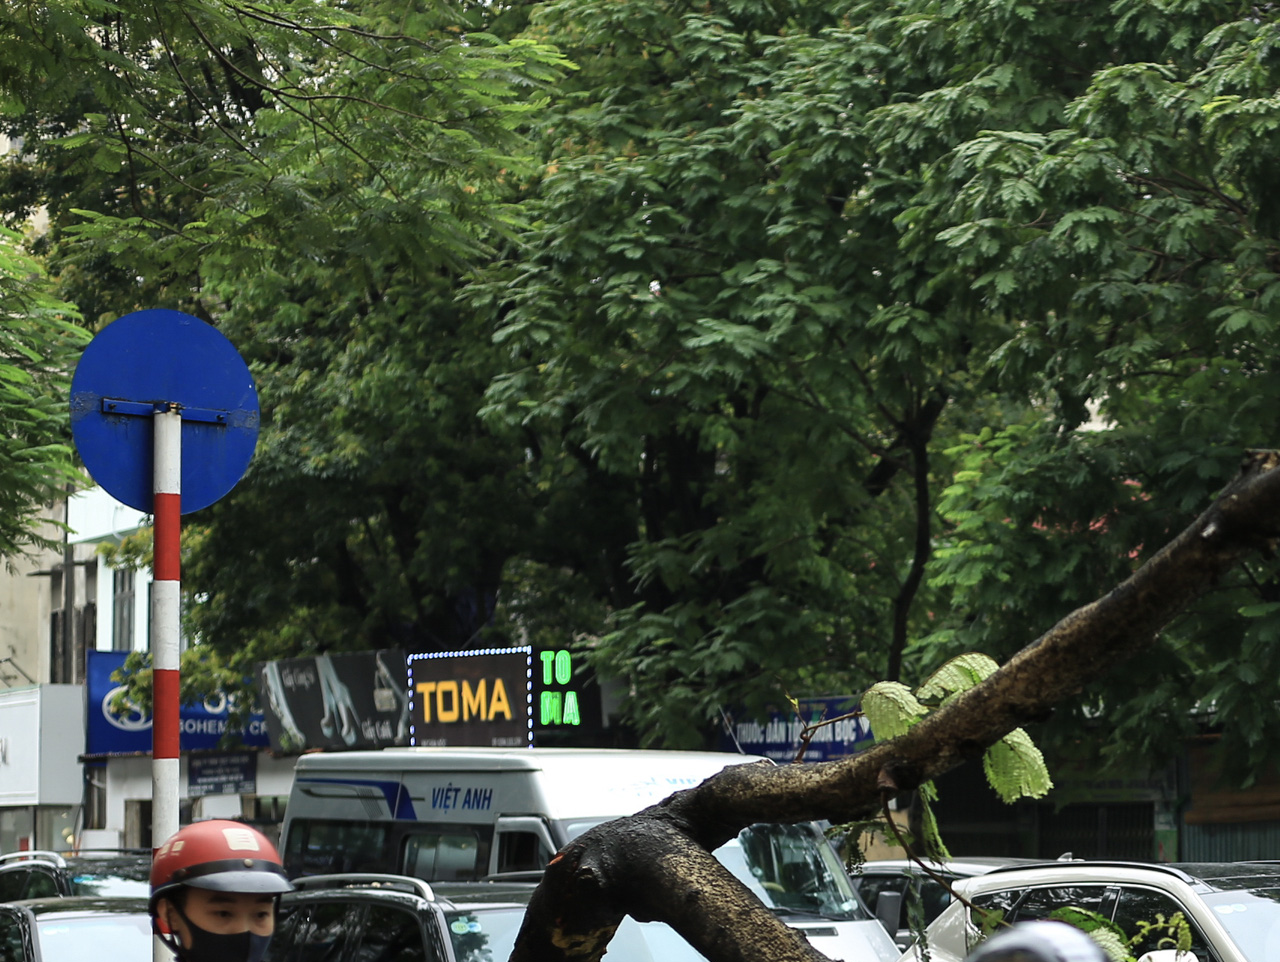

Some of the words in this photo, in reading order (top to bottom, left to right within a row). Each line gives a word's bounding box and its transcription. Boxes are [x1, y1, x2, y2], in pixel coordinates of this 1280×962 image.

[540, 650, 572, 685] TO
[416, 678, 512, 723] TOMA
[540, 691, 581, 726] MA
[432, 782, 461, 814] VIỆT
[462, 787, 493, 810] ANH
